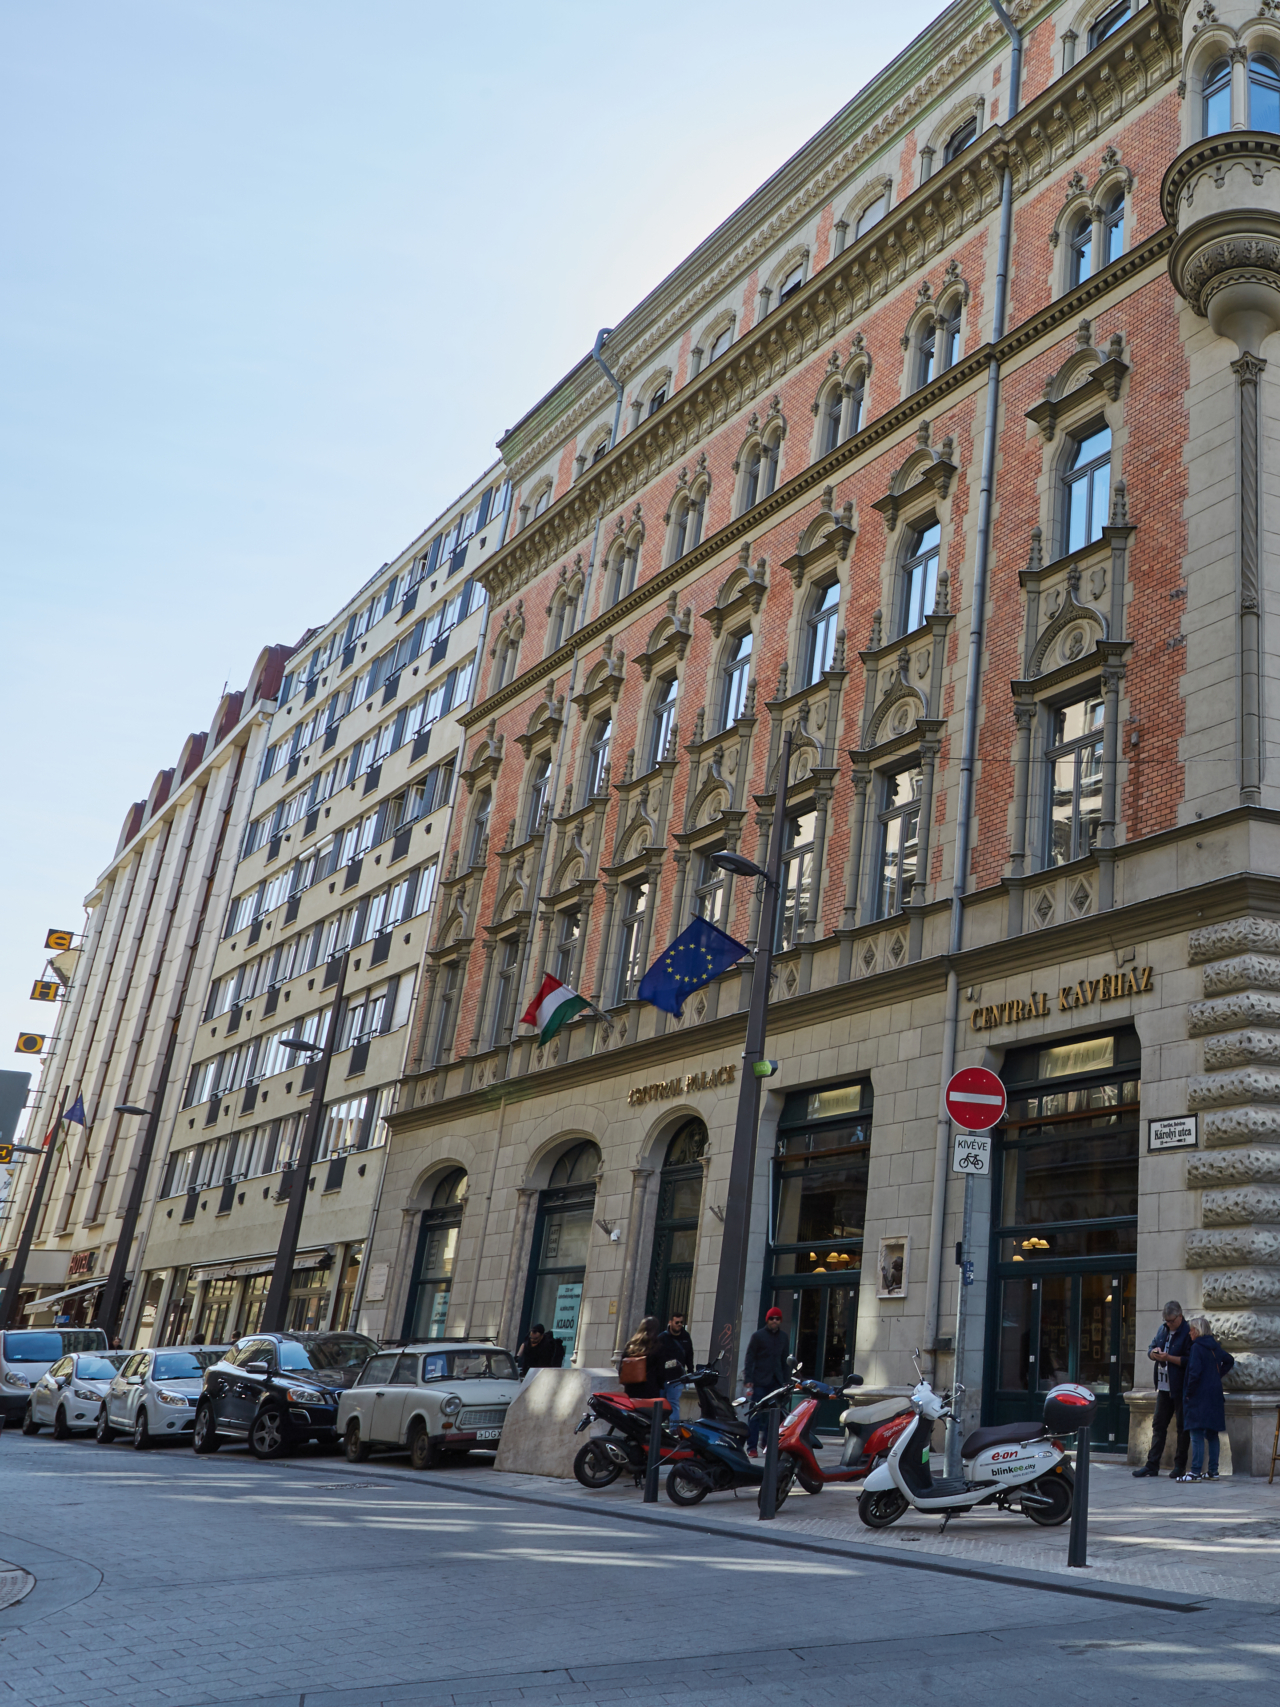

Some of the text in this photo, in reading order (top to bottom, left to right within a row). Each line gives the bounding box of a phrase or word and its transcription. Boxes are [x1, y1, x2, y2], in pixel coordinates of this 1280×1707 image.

[970, 966, 1154, 1031] CENTRÁL KÁVÉHÁZ
[684, 1063, 737, 1092] PALACE
[1154, 1127, 1192, 1140] Károlyi utca
[957, 1138, 988, 1151] KIVÉVE
[68, 1252, 92, 1275] HOTEL
[556, 1316, 574, 1329] KIADÓ
[991, 1463, 1036, 1476] blinkee.city
